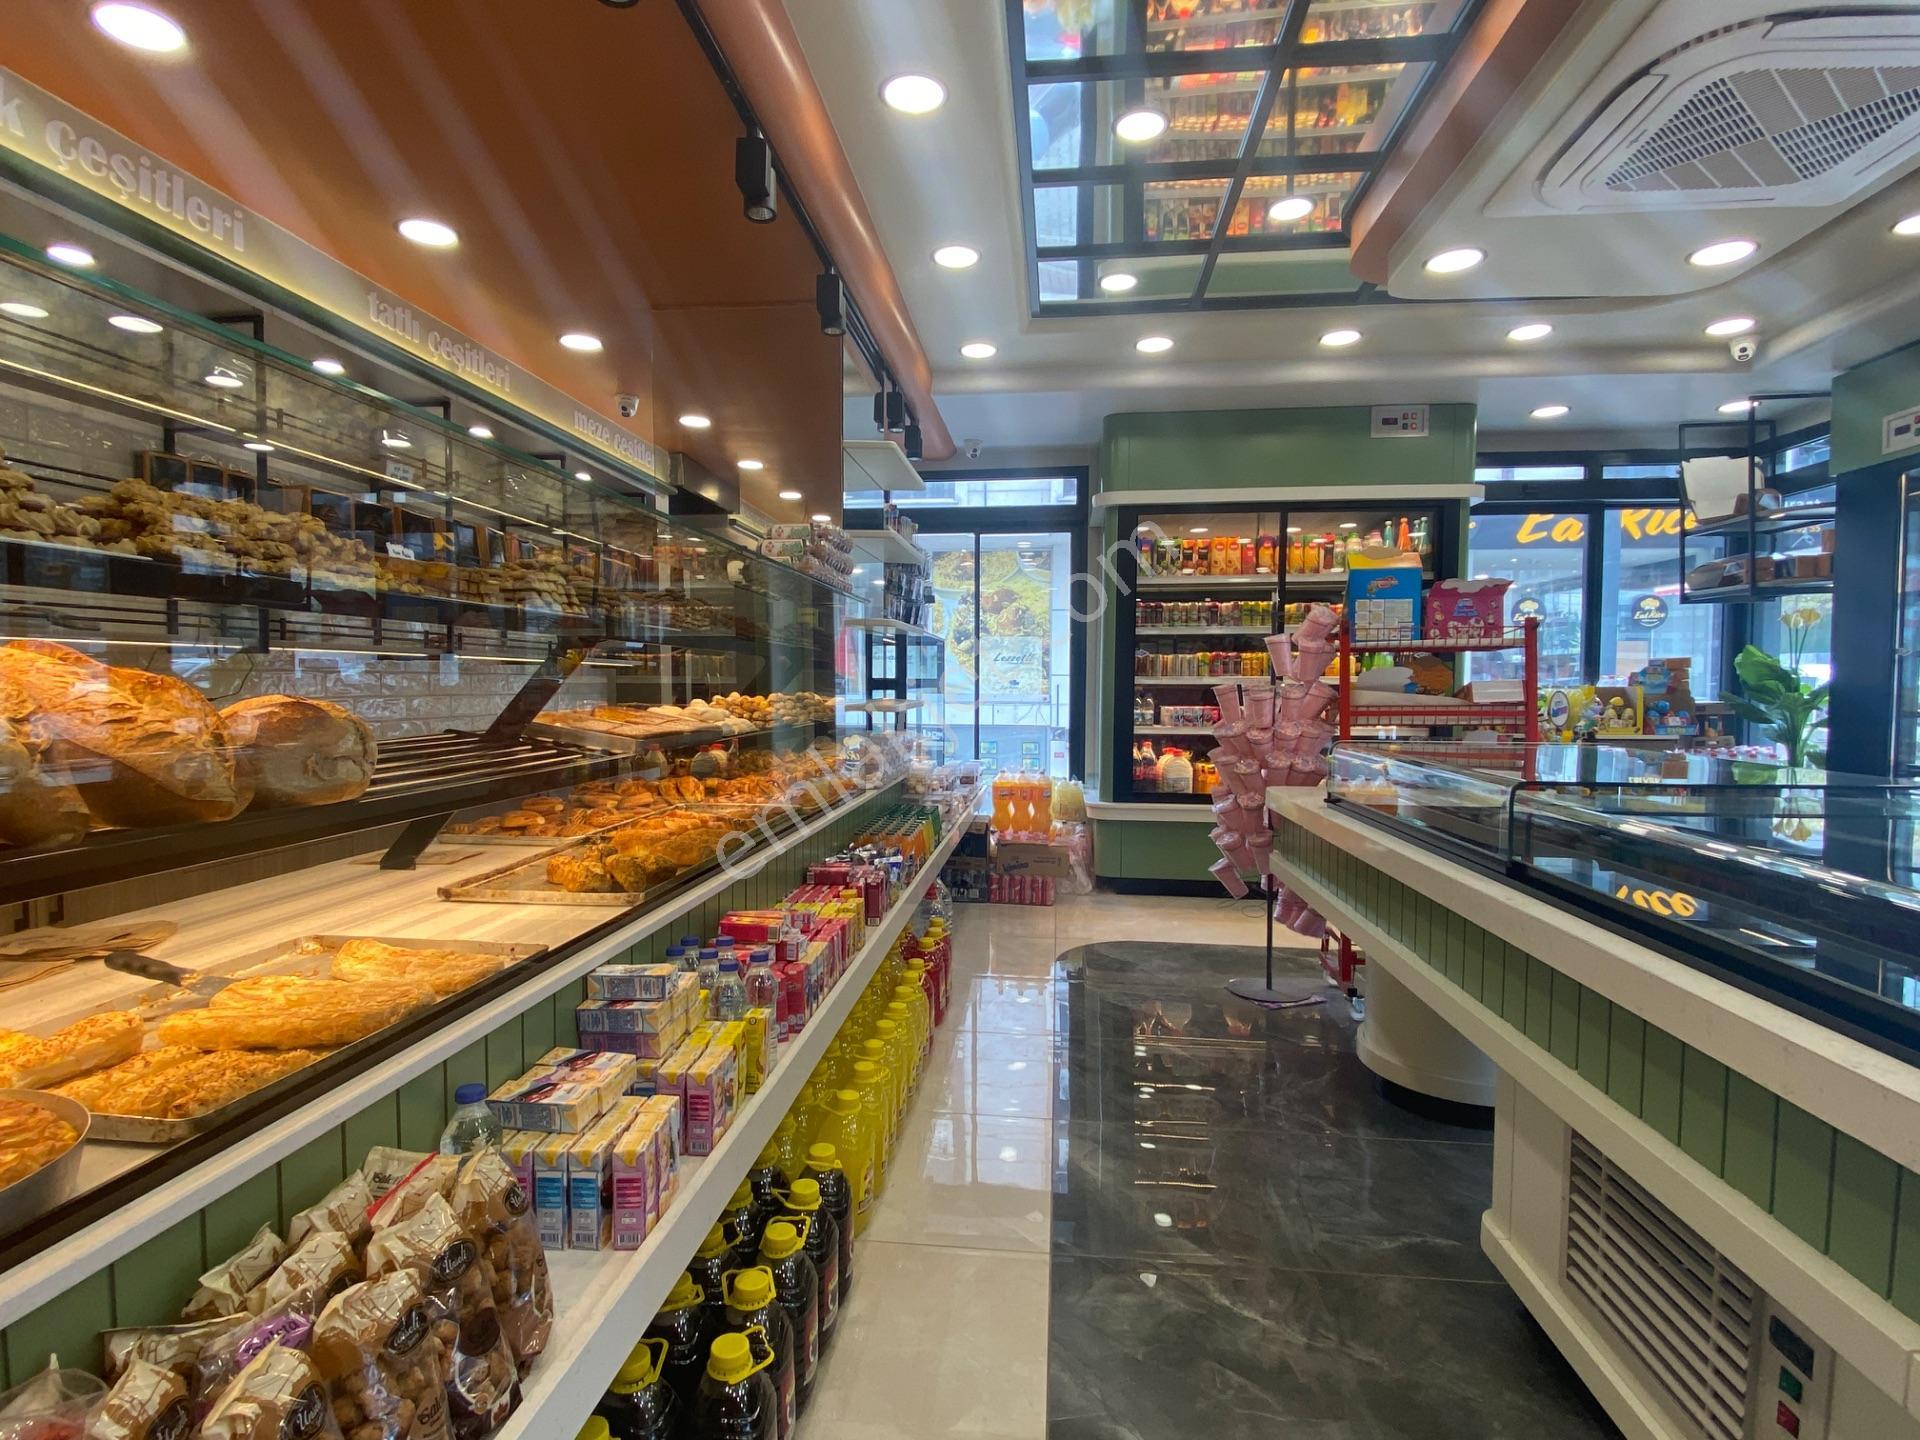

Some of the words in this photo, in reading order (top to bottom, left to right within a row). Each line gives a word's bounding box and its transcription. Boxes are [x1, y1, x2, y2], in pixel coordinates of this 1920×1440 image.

[45, 118, 245, 253] çeşitleri
[367, 291, 421, 344] tatlı
[427, 330, 511, 392] çeşitleri
[1516, 513, 1586, 544] Ea
